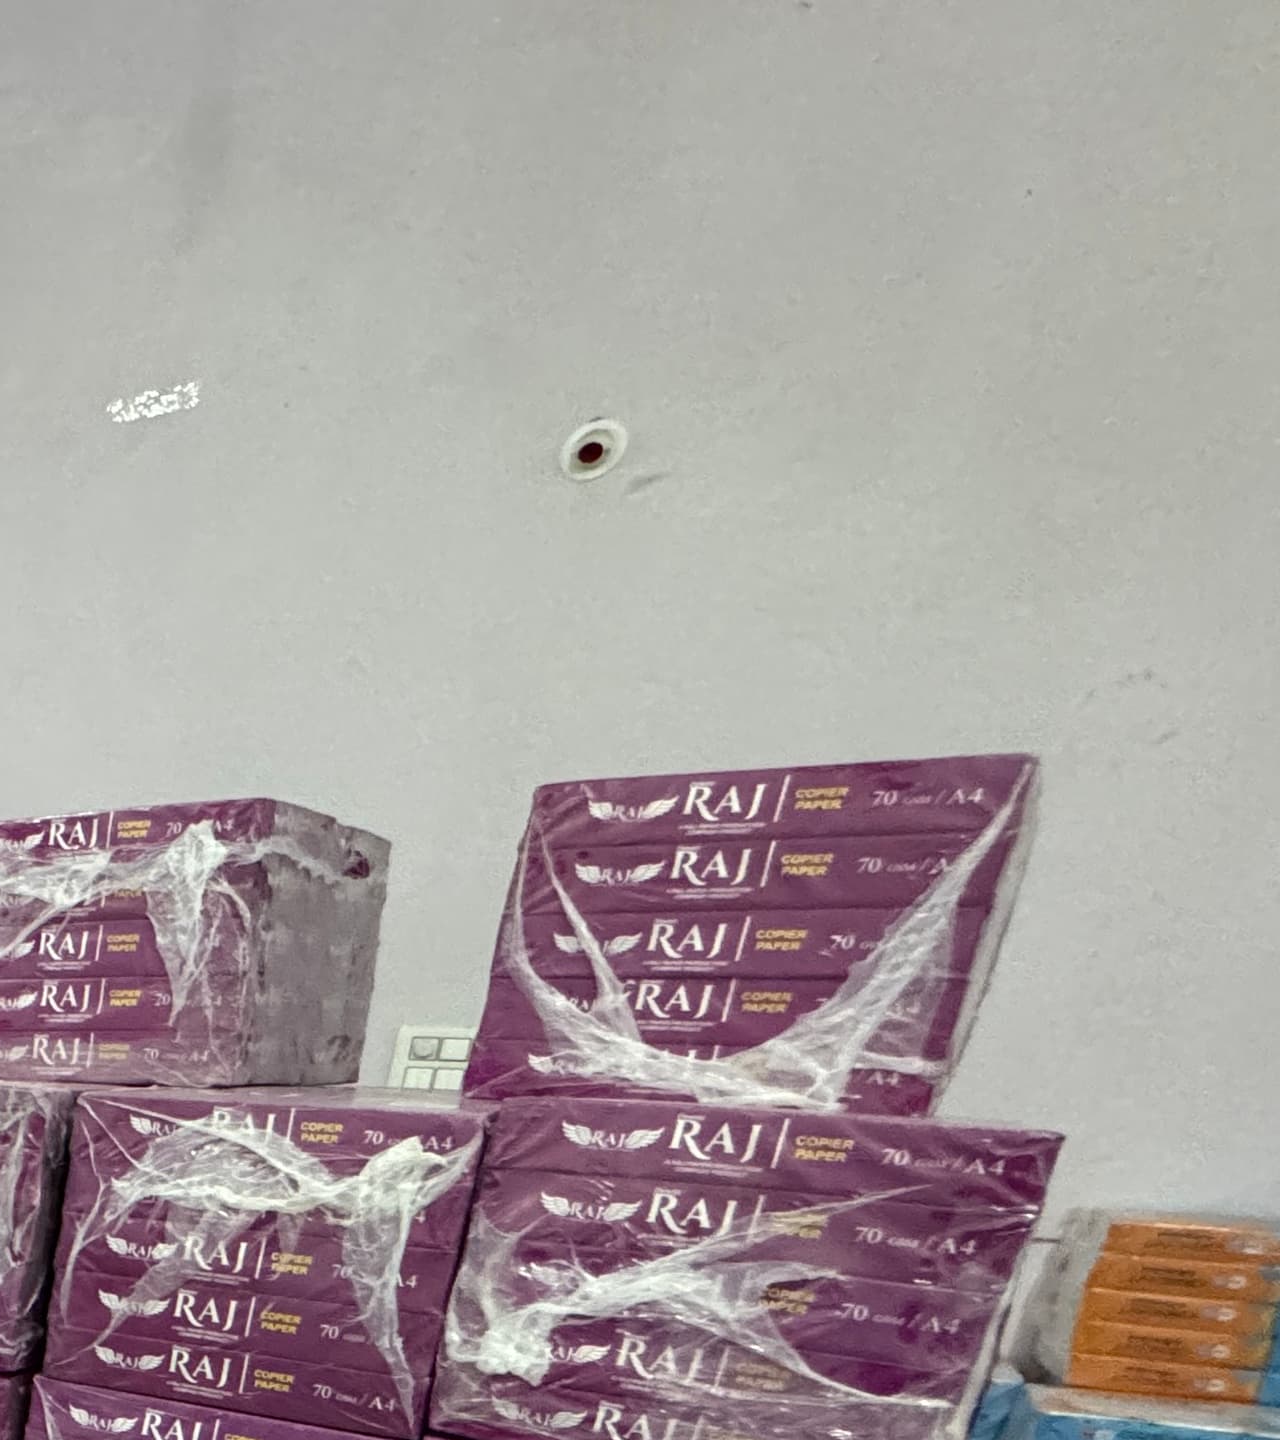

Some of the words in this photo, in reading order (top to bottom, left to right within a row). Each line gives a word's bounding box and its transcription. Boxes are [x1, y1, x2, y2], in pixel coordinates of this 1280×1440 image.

[795, 787, 850, 799] COPIER
[872, 791, 896, 806] 70
[951, 789, 984, 805] A4
[683, 782, 767, 821] RAJ
[795, 799, 842, 810] PAPER
[117, 821, 151, 831] COPIER
[48, 820, 99, 850] RAJ
[118, 829, 147, 839] PAPER
[669, 848, 754, 885] RAJ
[781, 854, 833, 865] COPIER
[857, 858, 882, 874] 70
[781, 865, 828, 876] PAPER
[107, 934, 140, 943] COPIER
[647, 923, 729, 959] RAJ
[756, 929, 807, 940] COPIER
[38, 932, 90, 960] RAJ
[108, 943, 136, 952] PAPER
[755, 940, 802, 951] PAPER
[40, 984, 92, 1013] RAJ
[634, 982, 714, 1020] RAJ
[742, 992, 793, 1002] COPIER
[741, 1001, 789, 1013] PAPER
[301, 1121, 343, 1133] COPIER
[301, 1132, 338, 1144] PAPER
[364, 1130, 384, 1144] 70
[425, 1134, 452, 1149] A4
[668, 1119, 762, 1160] RAJ
[795, 1136, 854, 1149] COPIER
[794, 1148, 848, 1162] PAPER
[882, 1150, 909, 1167] 70
[969, 1155, 1005, 1175] A4
[646, 1193, 738, 1234] RAJ
[855, 1227, 884, 1244] 70
[940, 1236, 976, 1255] A4
[184, 1236, 248, 1271] RAJ
[272, 1251, 313, 1265] COPIER
[174, 1294, 238, 1331] RAJ
[261, 1312, 301, 1324] COPIER
[840, 1303, 869, 1322] 70
[925, 1315, 960, 1334] A4
[260, 1321, 297, 1334] PAPER
[320, 1325, 338, 1339] 70
[616, 1336, 704, 1381] RAJ
[168, 1350, 232, 1387] RAJ
[255, 1369, 294, 1383] COPIER
[254, 1380, 289, 1392] PAPER
[313, 1385, 331, 1399] 70
[369, 1397, 395, 1411] A4
